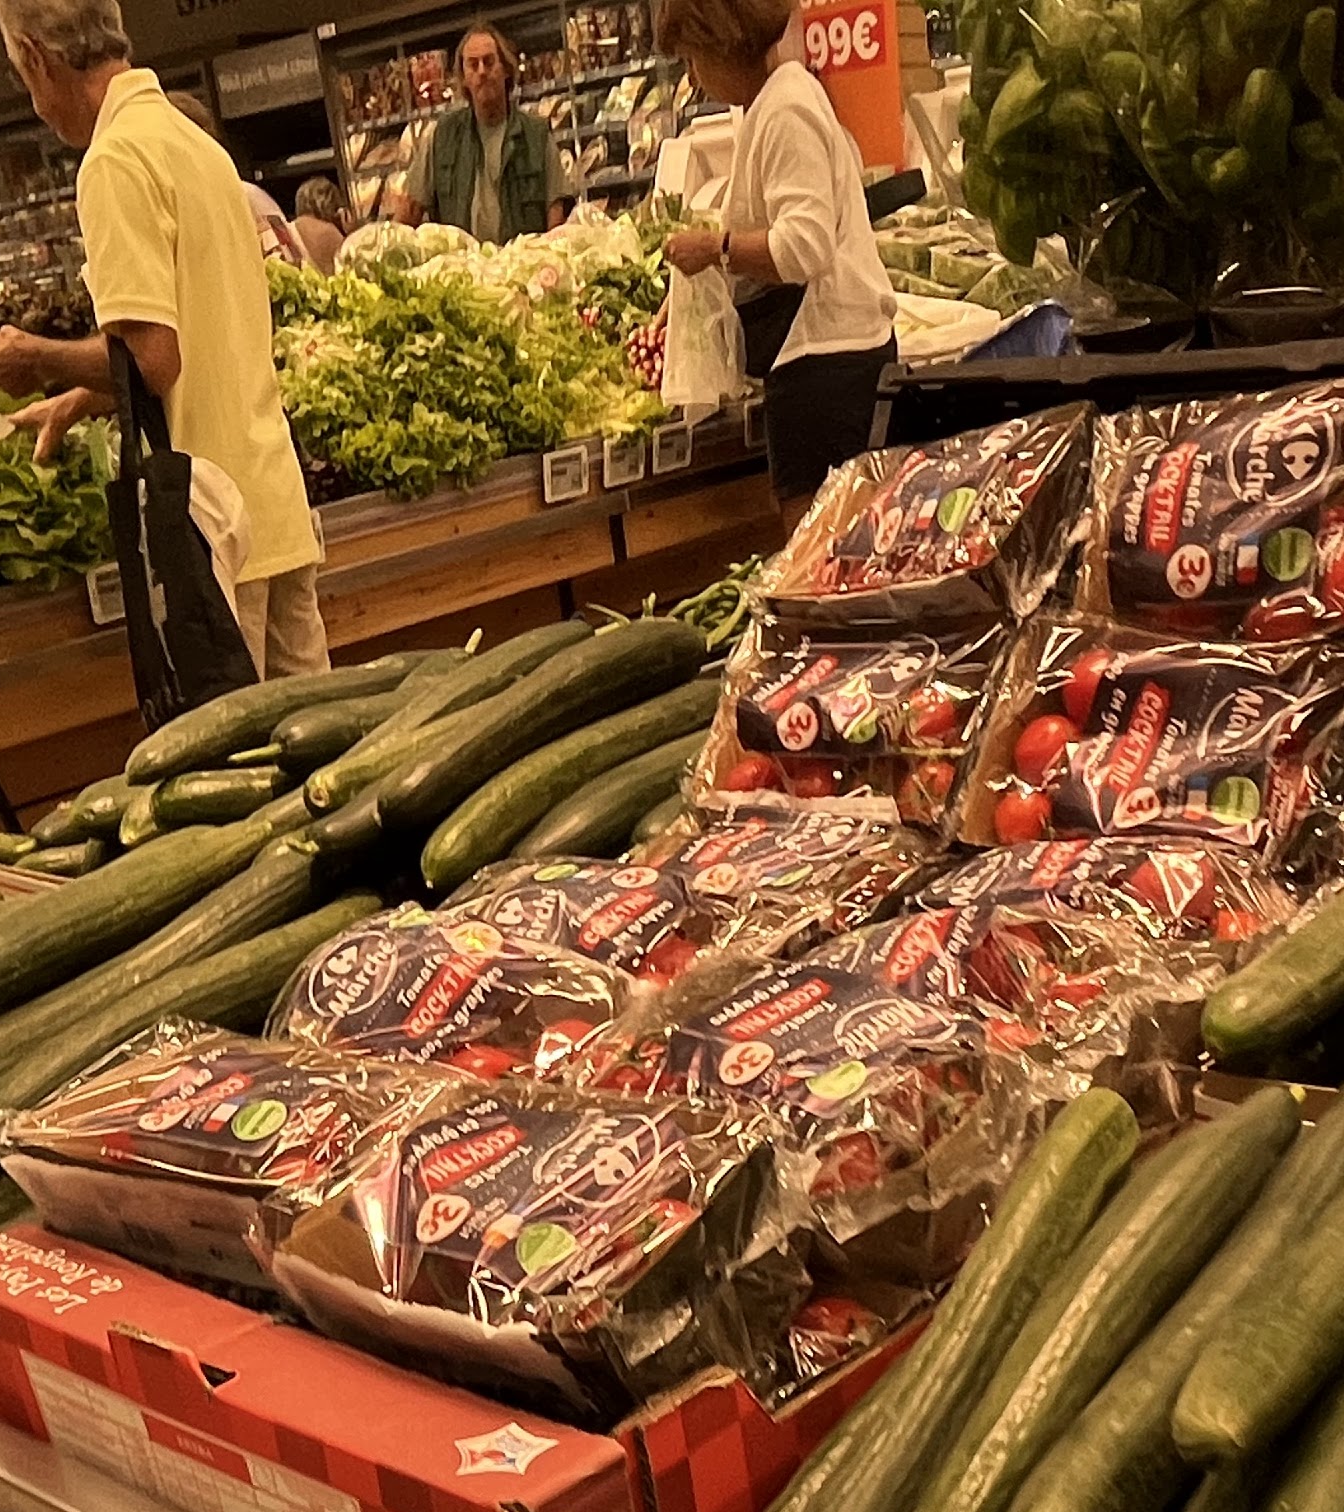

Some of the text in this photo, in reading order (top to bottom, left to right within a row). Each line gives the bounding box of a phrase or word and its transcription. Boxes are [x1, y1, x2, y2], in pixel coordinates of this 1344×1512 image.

[1109, 690, 1164, 790] COCKTAIL
[455, 966, 504, 1028] grappes
[730, 982, 824, 1038] COCKTAIL
[424, 1129, 517, 1184] COCKTAIL
[35, 1285, 88, 1315] Les
